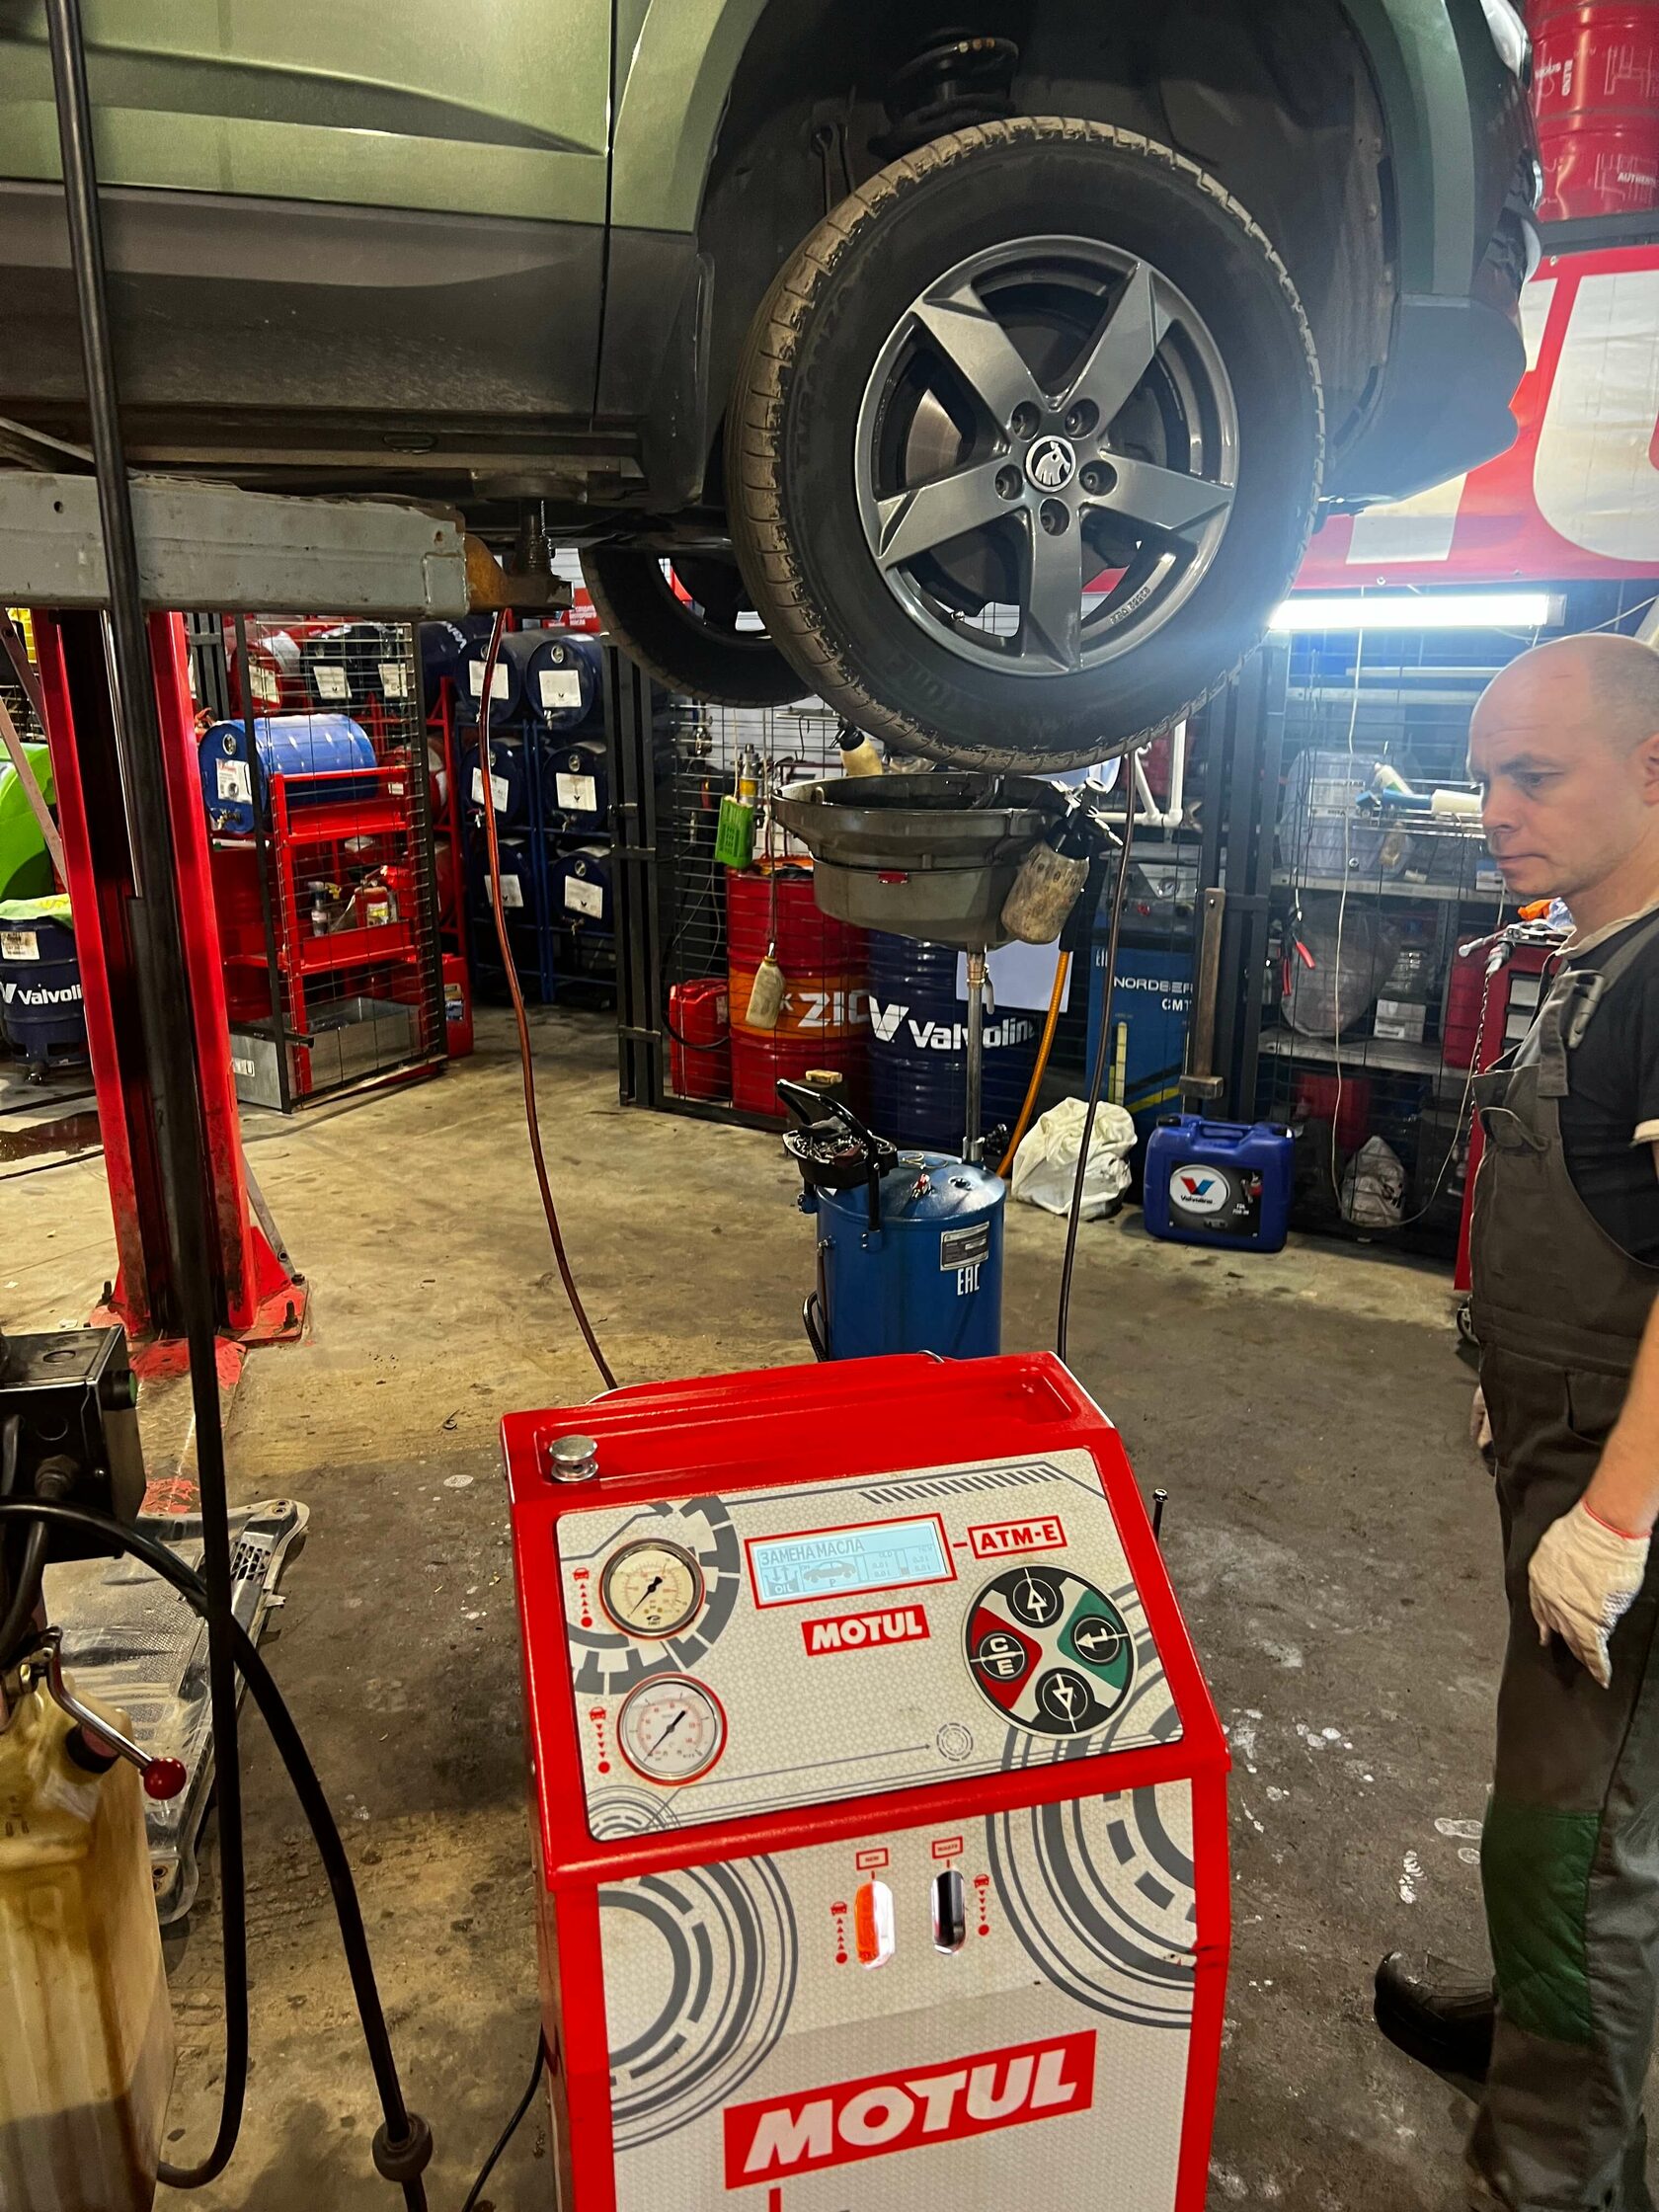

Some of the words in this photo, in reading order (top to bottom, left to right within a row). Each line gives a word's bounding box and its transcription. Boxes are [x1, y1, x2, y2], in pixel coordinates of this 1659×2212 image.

[18, 984, 82, 1005] Valvoli
[1113, 976, 1194, 994] NORDBER
[798, 989, 870, 1028] ZIC
[957, 1263, 981, 1296] EAC
[981, 1523, 1058, 1550] ATM-E
[760, 1546, 813, 1566] ЗАМЕНА
[816, 1538, 865, 1557] МАСЛА
[774, 1582, 794, 1595] OIL
[812, 1611, 922, 1650] MOTUL
[989, 1637, 1008, 1653] C
[996, 1659, 1015, 1676] E
[743, 2048, 1078, 2174] MOTUL
